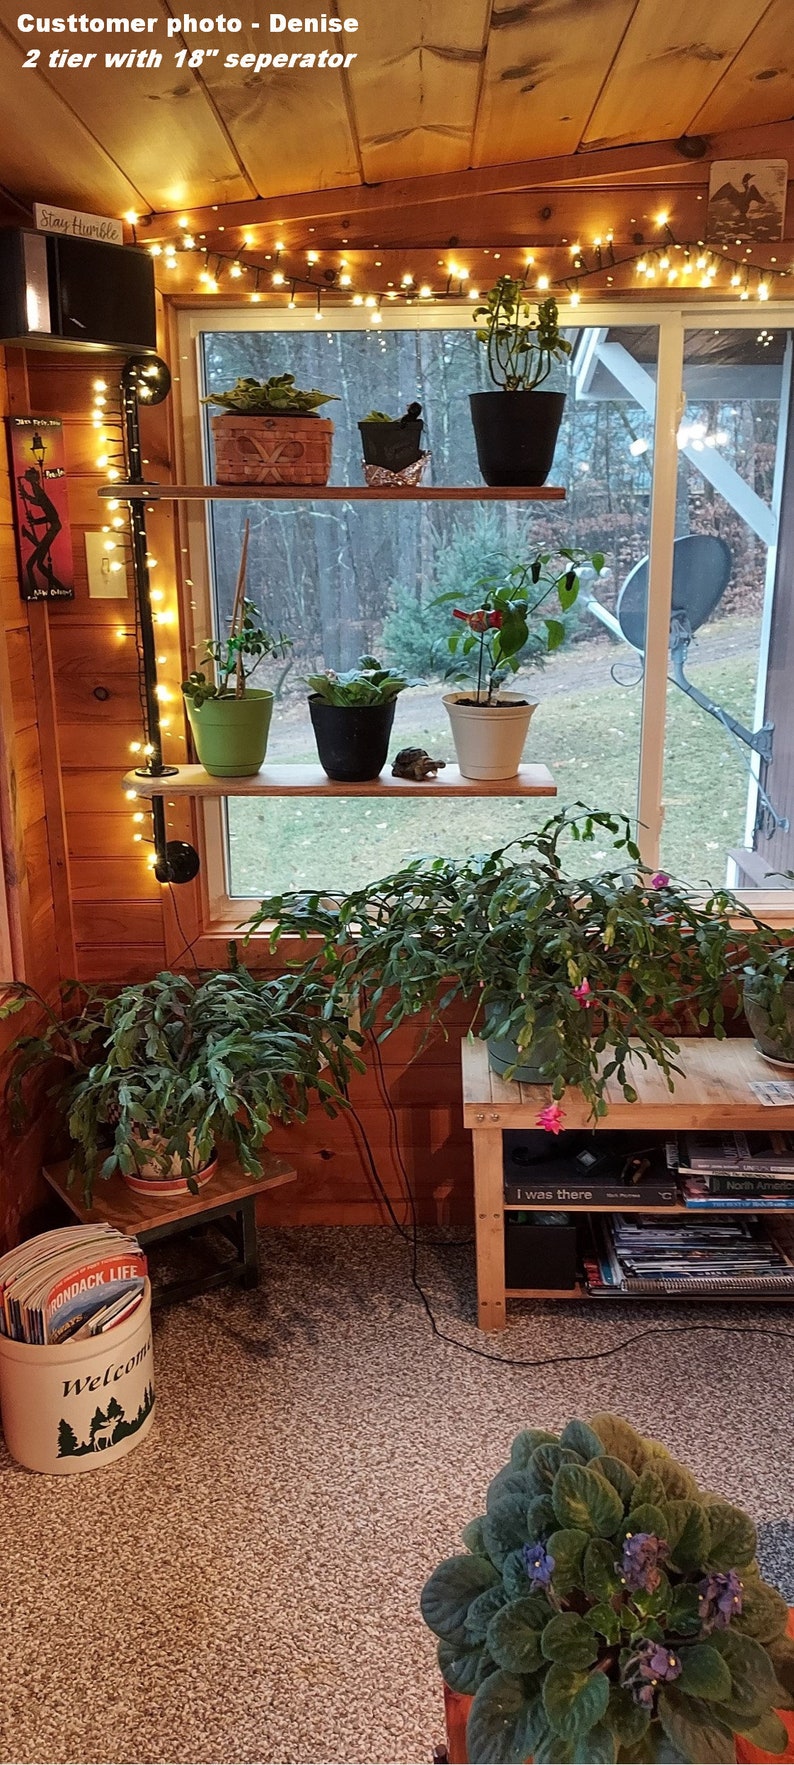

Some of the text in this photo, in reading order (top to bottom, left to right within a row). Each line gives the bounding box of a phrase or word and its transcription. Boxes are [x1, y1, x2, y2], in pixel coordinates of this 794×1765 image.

[41, 209, 119, 240] Stay Humble
[726, 1181, 754, 1190] North
[517, 1188, 593, 1200] i was there
[109, 1265, 138, 1282] LIFE
